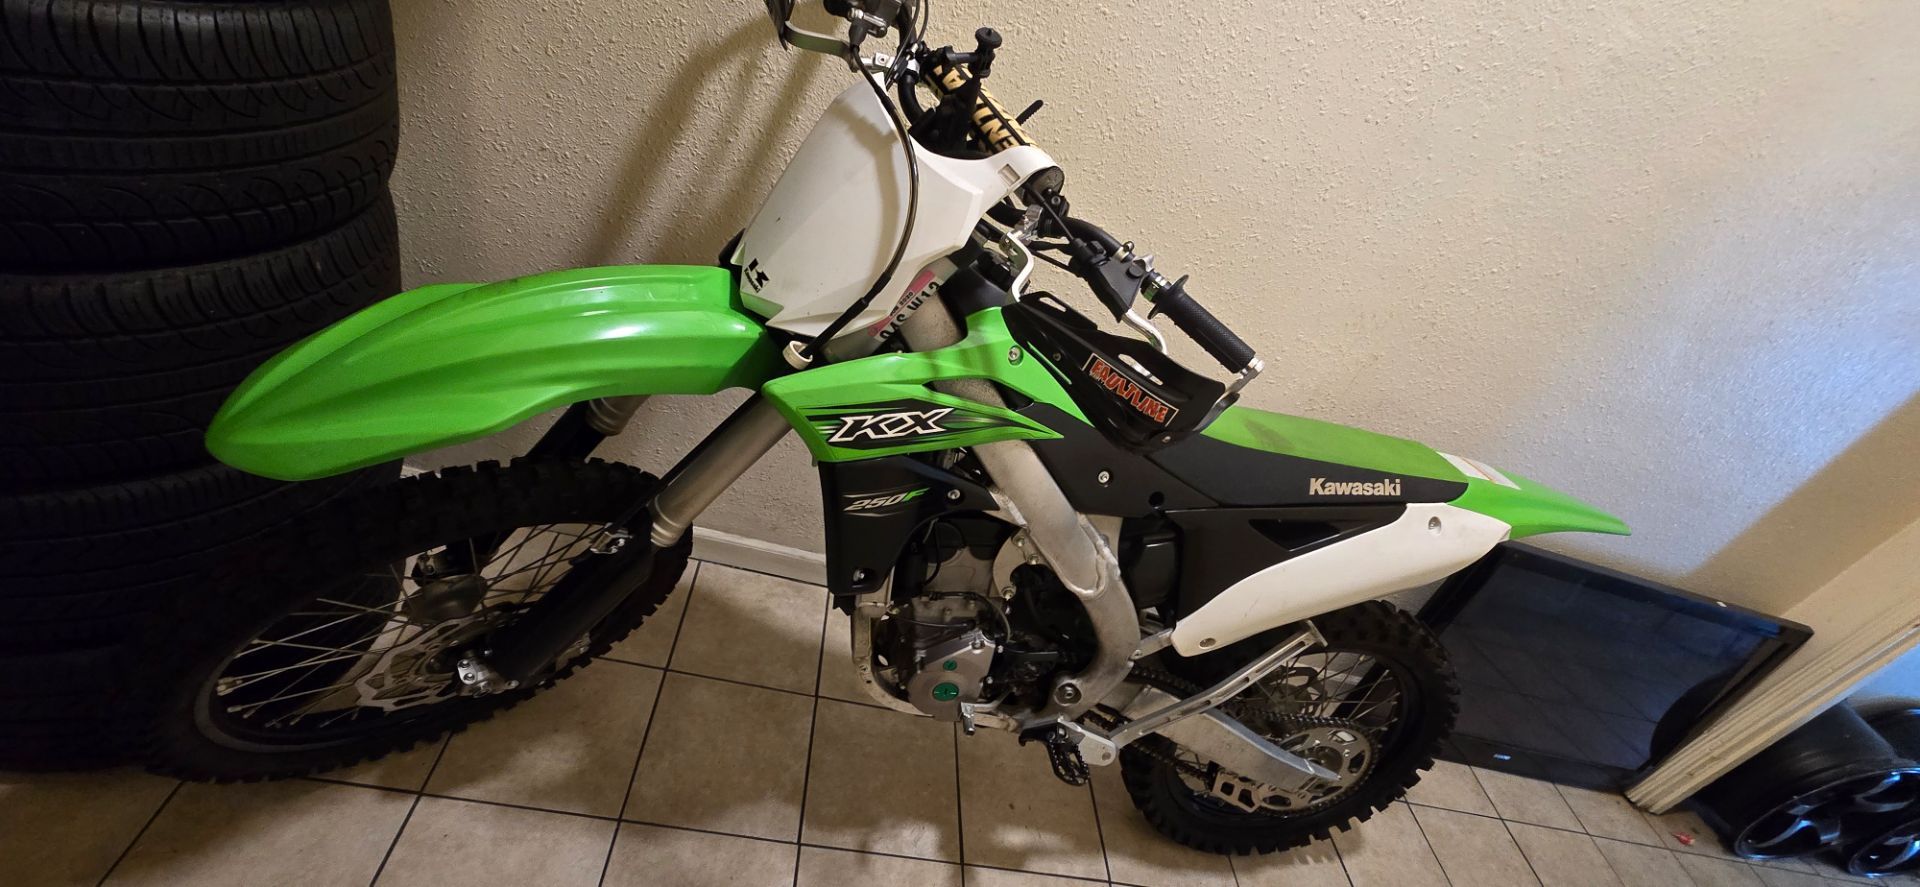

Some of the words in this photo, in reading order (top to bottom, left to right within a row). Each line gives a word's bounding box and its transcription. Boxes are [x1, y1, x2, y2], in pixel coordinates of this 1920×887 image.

[1089, 359, 1169, 423] FAULTLINE
[828, 407, 955, 442] KX
[843, 487, 930, 511] 250F
[1309, 478, 1401, 496] Kawasaki
